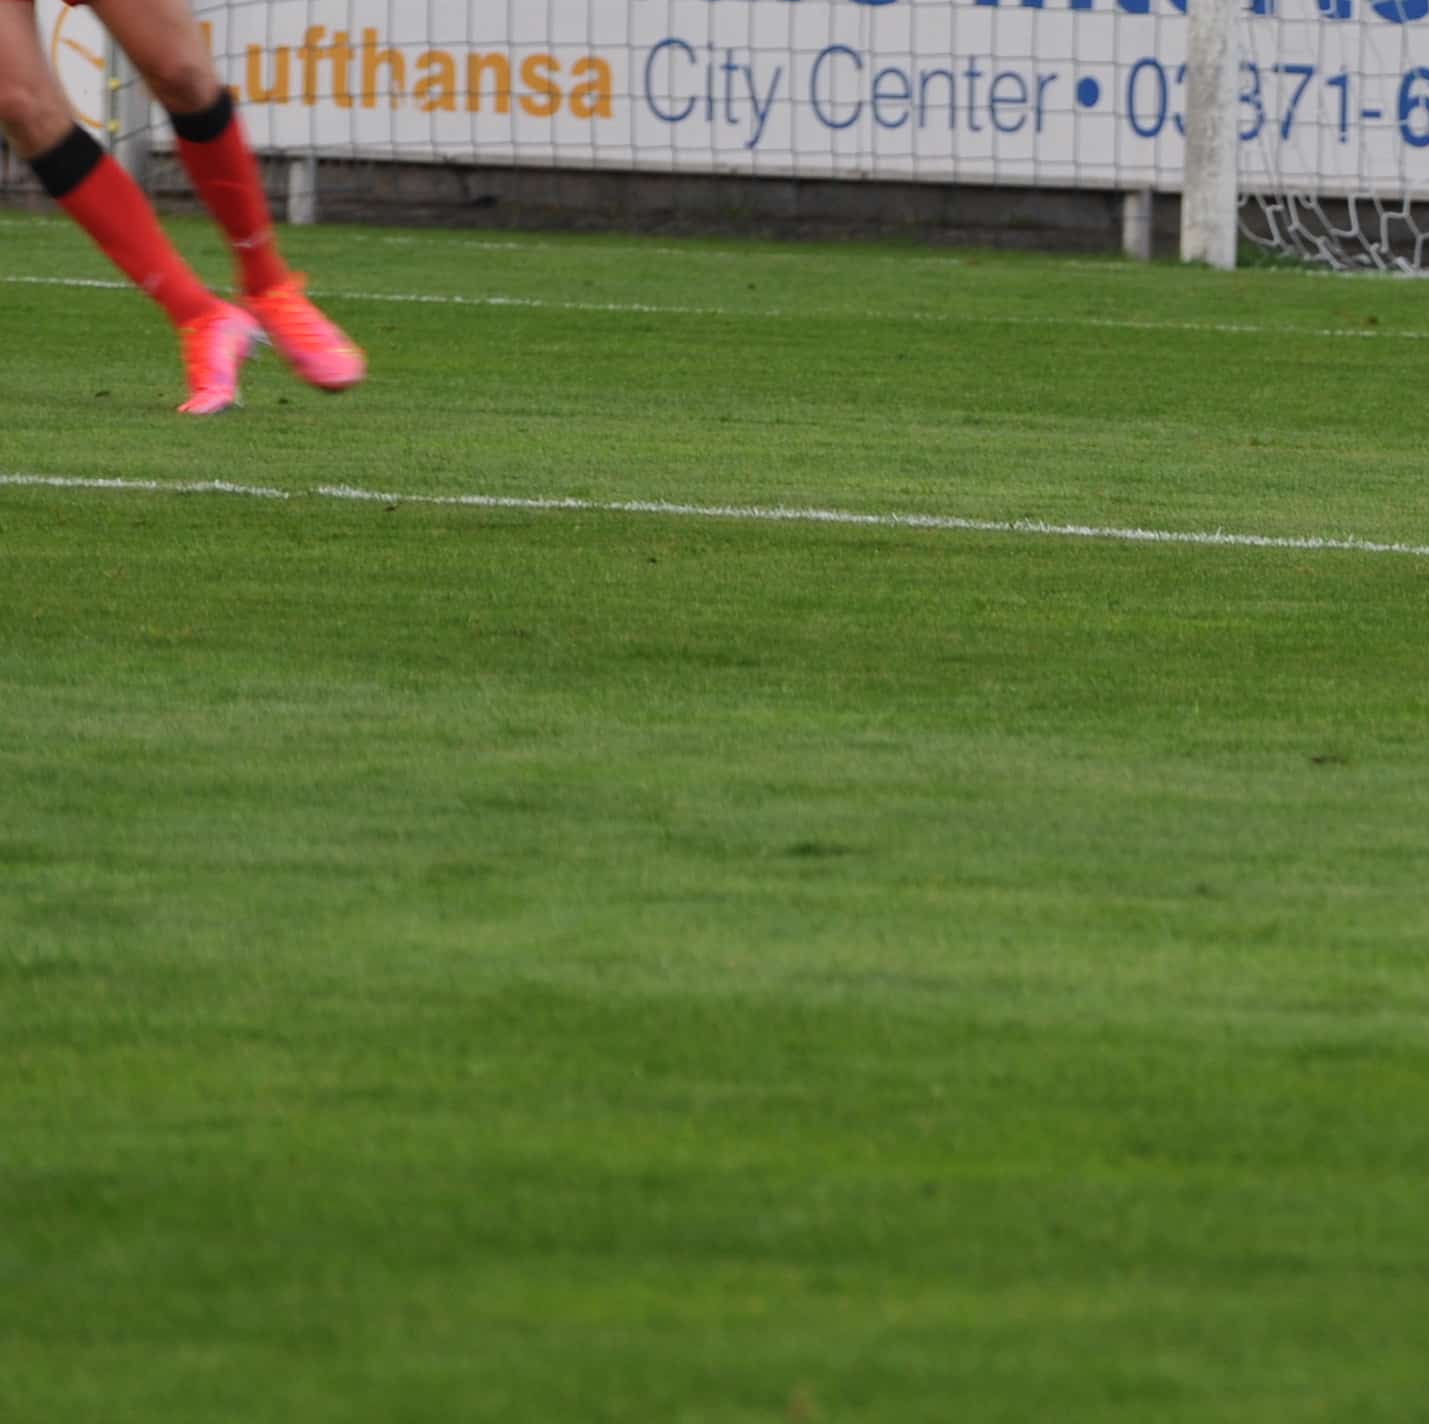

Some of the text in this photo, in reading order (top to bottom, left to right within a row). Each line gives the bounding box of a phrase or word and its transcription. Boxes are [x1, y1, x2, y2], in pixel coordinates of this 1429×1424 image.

[201, 21, 613, 119] ufthansa
[646, 37, 782, 149] City
[810, 43, 1057, 134] Center
